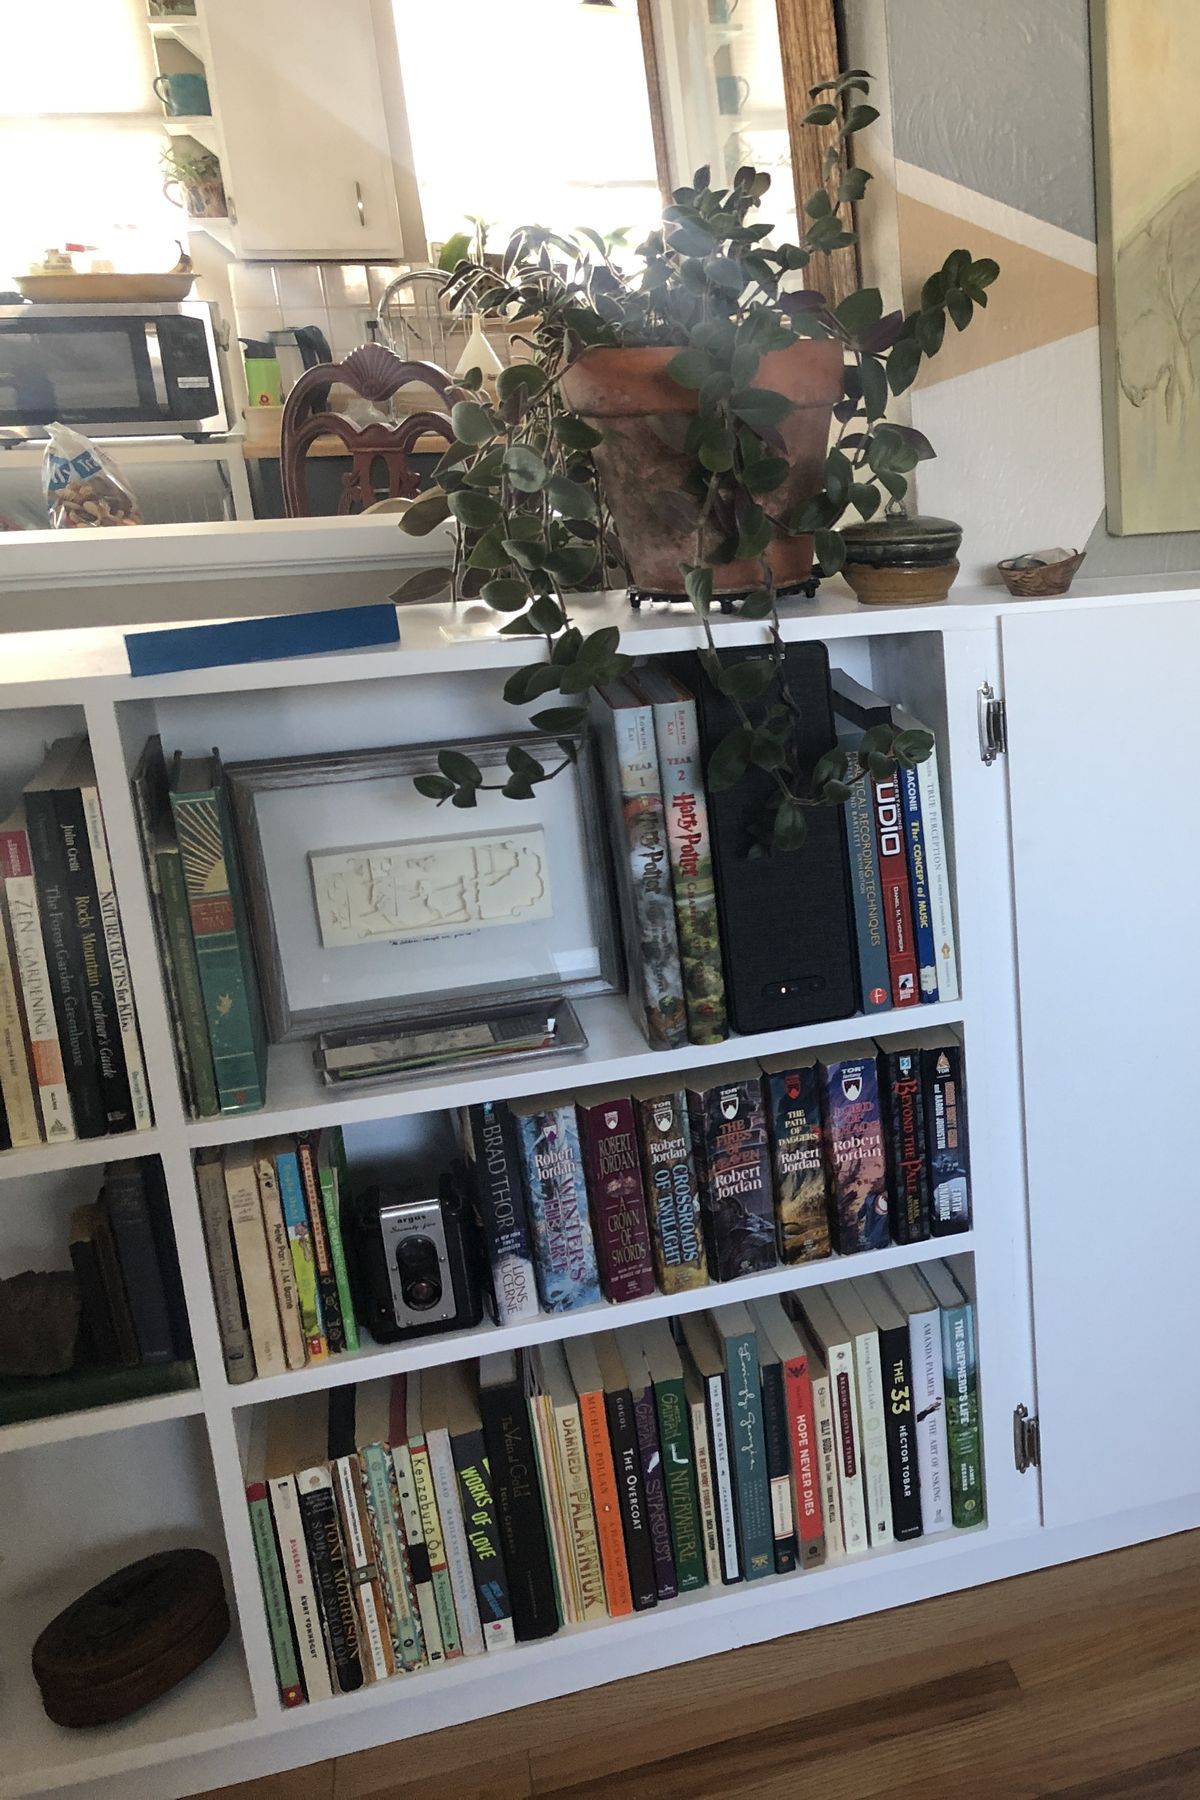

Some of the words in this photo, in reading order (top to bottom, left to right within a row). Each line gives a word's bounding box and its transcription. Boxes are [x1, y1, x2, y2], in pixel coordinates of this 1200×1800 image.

[639, 715, 648, 751] ROWLING
[678, 710, 687, 746] ROWLING
[627, 762, 653, 771] YEAR
[667, 756, 693, 766] YEAR
[677, 770, 686, 781] 2
[906, 768, 918, 812] MACONIE
[928, 783, 937, 810] TRUE
[671, 792, 699, 834] Harry
[875, 781, 901, 857] UDIO
[60, 823, 77, 846] John
[635, 810, 660, 850] Harry
[860, 812, 874, 878] RECORDING
[911, 821, 921, 842] The
[931, 812, 943, 870] PERCEPTION
[674, 832, 702, 878] Potter
[914, 845, 926, 886] CONCEPT
[638, 849, 664, 893] Potter
[46, 884, 62, 910] The
[917, 887, 926, 898] of
[15, 899, 37, 933] ZEN
[74, 895, 95, 929] Rocky
[100, 890, 121, 940] NATURE
[866, 879, 881, 947] TECHNIQUES
[918, 900, 929, 929] MUSIC
[49, 911, 65, 948] Forest
[55, 949, 75, 994] Garden
[82, 932, 100, 988] Mountain
[108, 941, 127, 987] CRAFTS
[24, 946, 50, 1035] GARDENING
[64, 996, 85, 1067] Greenhouse
[91, 990, 110, 1048] Gardener's
[99, 1047, 118, 1080] Guide
[841, 1067, 862, 1075] TOR
[652, 1101, 671, 1109] TOR
[787, 1109, 806, 1119] THE
[847, 1113, 864, 1123] OF
[892, 1080, 919, 1133] BEYOND
[719, 1119, 746, 1135] THE
[784, 1118, 807, 1129] PATH
[790, 1126, 802, 1135] OF
[483, 1124, 507, 1175] BRAD
[598, 1132, 632, 1157] ROBERT
[650, 1137, 686, 1154] Robert
[716, 1131, 753, 1148] FIRES
[778, 1132, 819, 1147] DAGGERS
[832, 1135, 881, 1153] Robert
[903, 1134, 915, 1160] THE
[534, 1147, 574, 1169] Robert
[598, 1150, 636, 1177] JORDAN
[651, 1147, 688, 1165] Jordan
[711, 1150, 760, 1173] HEAVEN
[781, 1147, 820, 1164] Robert
[781, 1158, 821, 1174] Jordan
[833, 1147, 882, 1165] Jordan
[537, 1162, 577, 1181] Jordan
[654, 1169, 671, 1191] OF
[714, 1165, 761, 1189] Robert
[898, 1160, 923, 1197] PALE
[491, 1175, 515, 1232] THOR
[619, 1196, 626, 1212] A
[716, 1178, 763, 1201] Jordan
[938, 1183, 951, 1222] UNAWARE
[951, 1187, 962, 1213] EARTH
[396, 1213, 427, 1224] argus
[607, 1208, 642, 1233] CROWN
[672, 1163, 699, 1263] CROSSROADS
[273, 1223, 283, 1245] Peter
[559, 1176, 586, 1282] WINTER'S
[620, 1230, 633, 1247] OF
[658, 1194, 682, 1266] TWILIGHT
[277, 1246, 285, 1262] Pan
[612, 1243, 647, 1267] SWORDS
[512, 1264, 529, 1304] LIONS
[922, 1322, 934, 1361] AMANDA
[954, 1318, 965, 1340] THE
[893, 1359, 905, 1385] THE
[926, 1361, 935, 1397] PALMER
[955, 1340, 968, 1401] SHEPHERD'S
[839, 1376, 847, 1407] READING
[891, 1385, 911, 1416] 33
[616, 1396, 627, 1431] GOGOL
[636, 1403, 657, 1450] GAIMAN
[661, 1393, 682, 1441] GAIMAN
[841, 1409, 849, 1434] LOLITA
[928, 1419, 938, 1436] THE
[959, 1401, 970, 1425] LIFE
[586, 1395, 600, 1446] MICHAEL
[594, 1452, 609, 1494] POLLAN
[740, 1411, 758, 1471] Georgia
[796, 1414, 809, 1447] HOPE
[898, 1424, 909, 1463] HÉCTOR
[562, 1418, 582, 1476] DAMNED
[623, 1448, 634, 1472] THE
[698, 1446, 706, 1457] THE
[716, 1431, 725, 1462] CASTLE
[929, 1437, 938, 1456] ART
[930, 1456, 939, 1468] OF
[699, 1457, 708, 1471] BEST
[799, 1448, 812, 1488] NEVER
[438, 1466, 450, 1498] GILEAD
[460, 1465, 494, 1508] WORKS
[509, 1463, 532, 1498] Gold
[901, 1464, 912, 1498] TOBAR
[931, 1470, 942, 1502] ASKING
[626, 1474, 643, 1531] OVERCOAT
[702, 1488, 712, 1510] STORIES
[721, 1486, 731, 1525] JEANNETTE
[803, 1490, 815, 1517] DIES
[471, 1510, 493, 1527] OF
[646, 1479, 672, 1562] STARDUST
[705, 1518, 714, 1530] JACK
[468, 1530, 497, 1561] LOVE
[569, 1487, 605, 1609] PALAHNIUK
[707, 1530, 715, 1551] LONDON
[324, 1520, 343, 1562] TONI
[334, 1569, 360, 1659] MORRISON
[300, 1594, 310, 1616] KURT
[305, 1618, 318, 1659] VONNEGUT
